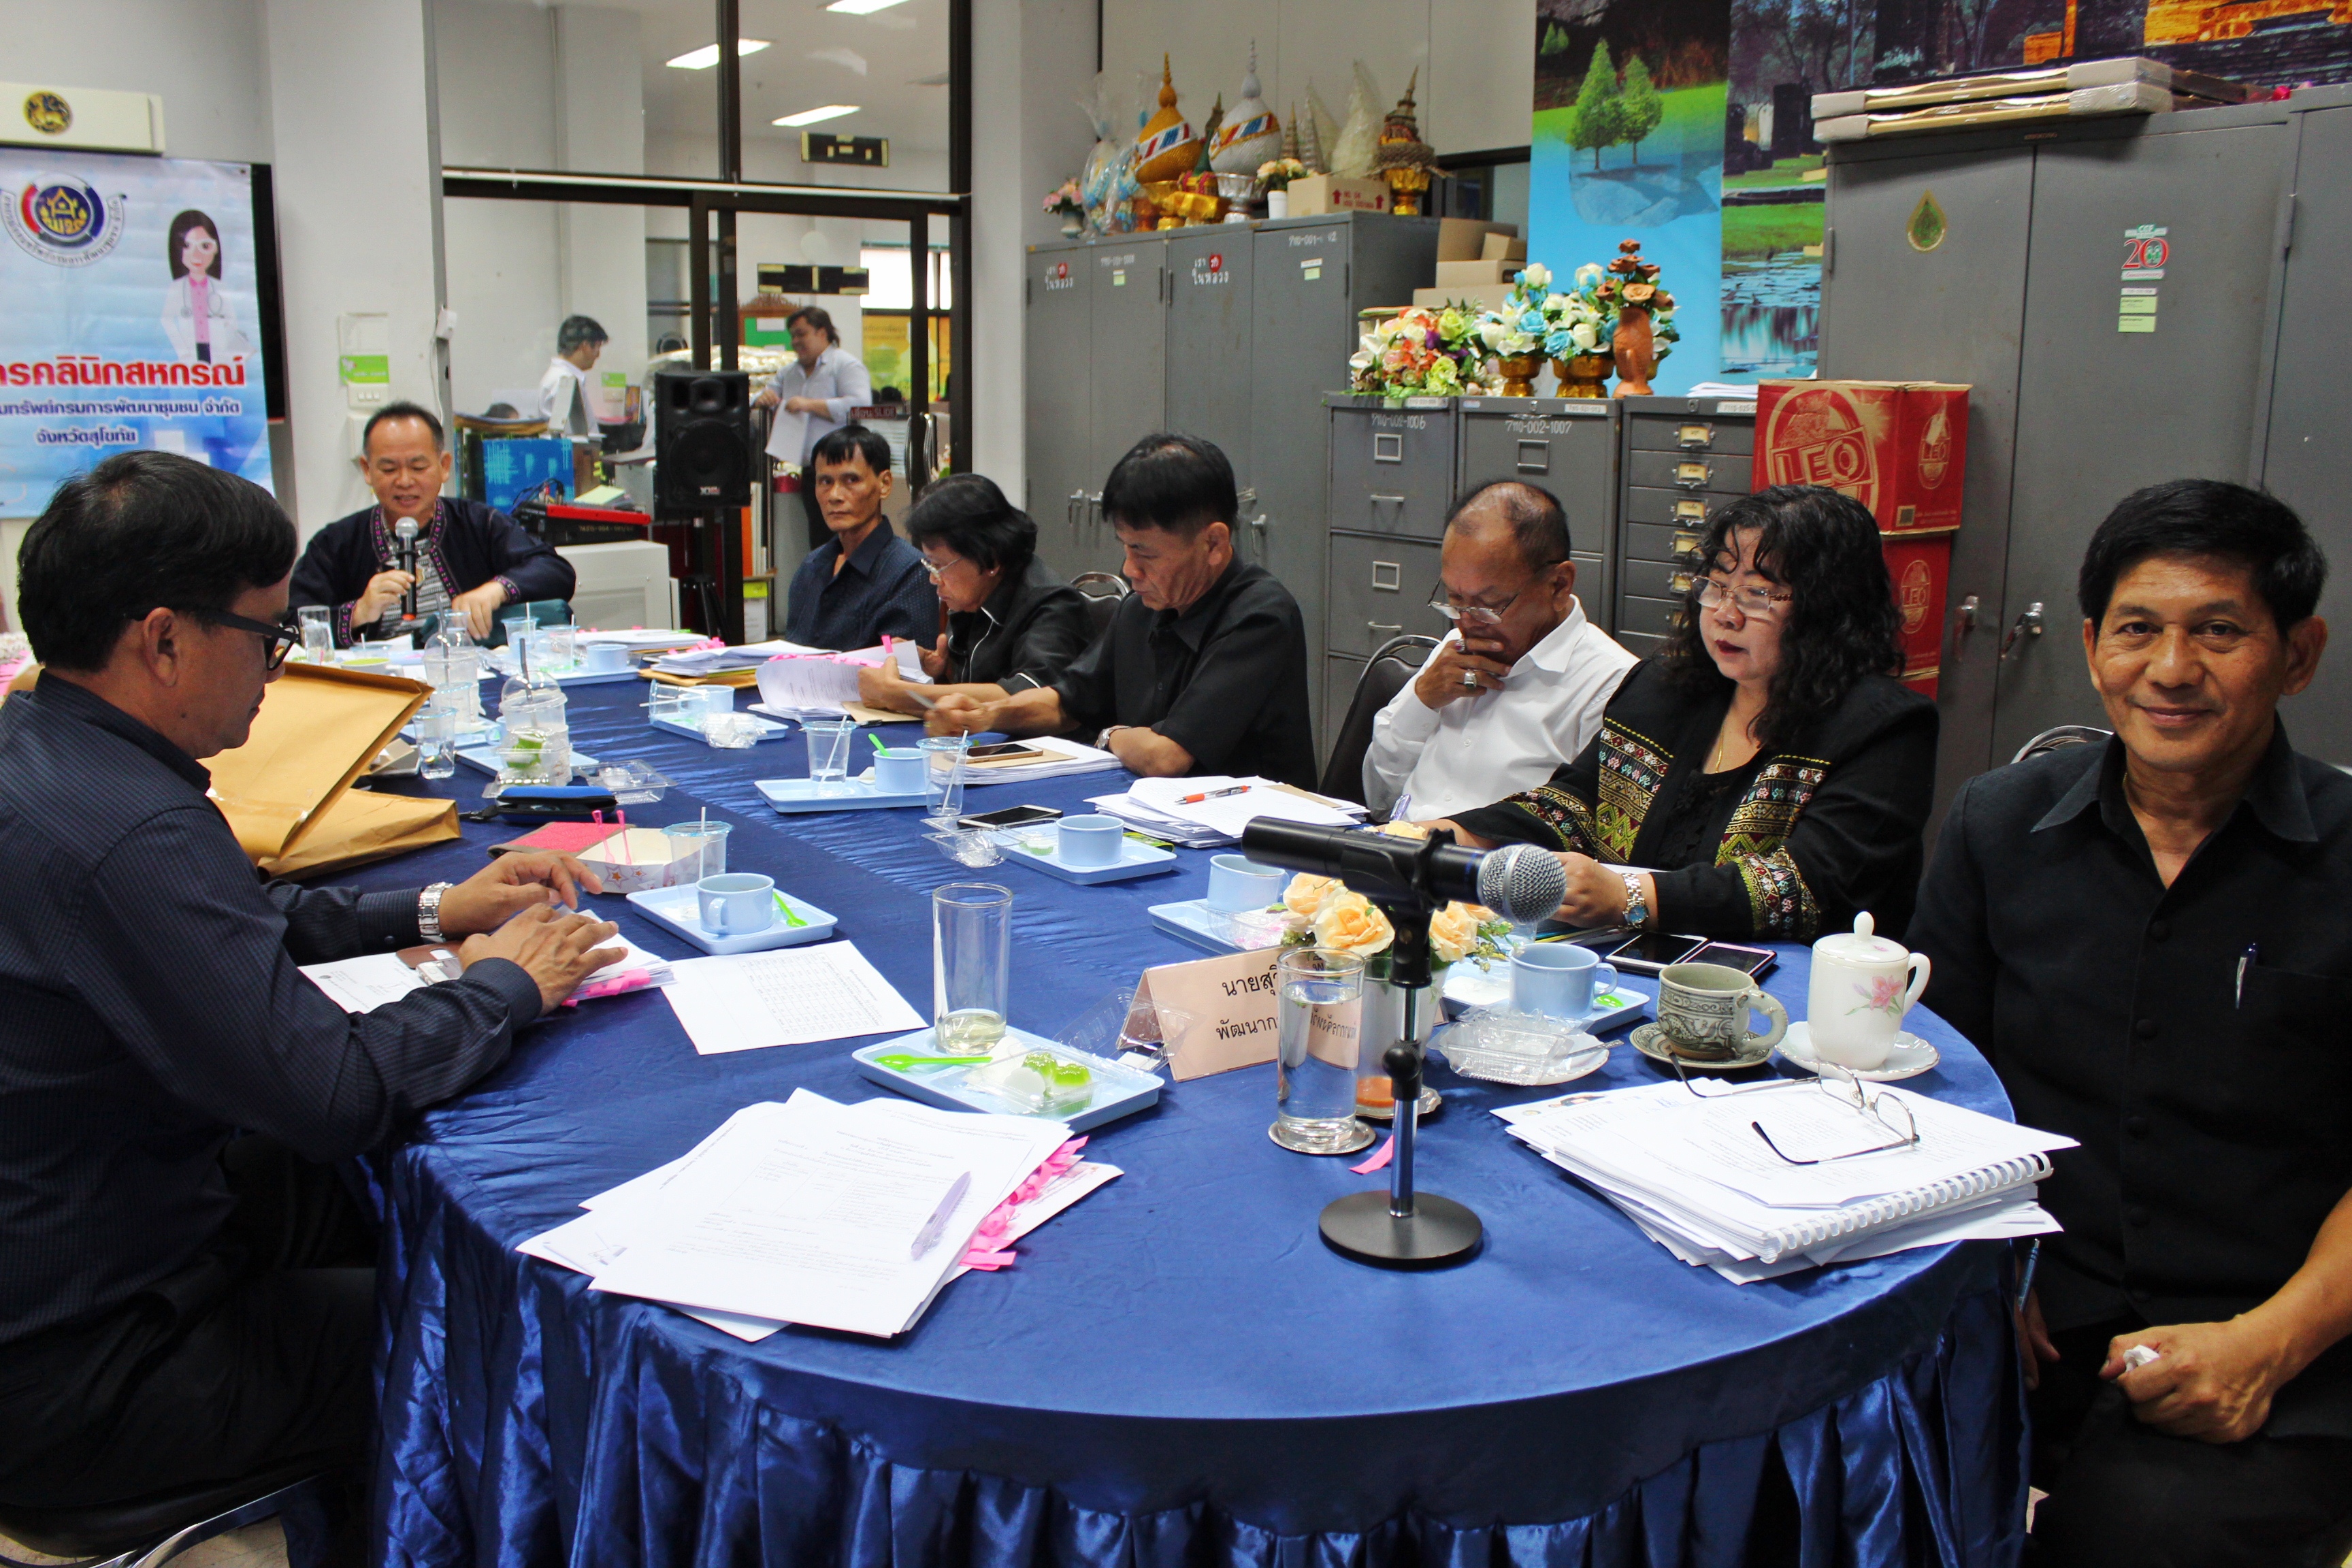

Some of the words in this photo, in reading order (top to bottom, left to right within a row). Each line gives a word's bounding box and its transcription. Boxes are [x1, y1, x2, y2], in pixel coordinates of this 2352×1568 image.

[2121, 238, 2170, 269] 20
[37, 427, 136, 446] จังหวัดสุโขทัย
[1775, 436, 1867, 486] LEO
[1923, 442, 1947, 459] LEO
[1904, 588, 1926, 606] LEO
[1216, 1017, 1278, 1041] พัฒนาก
